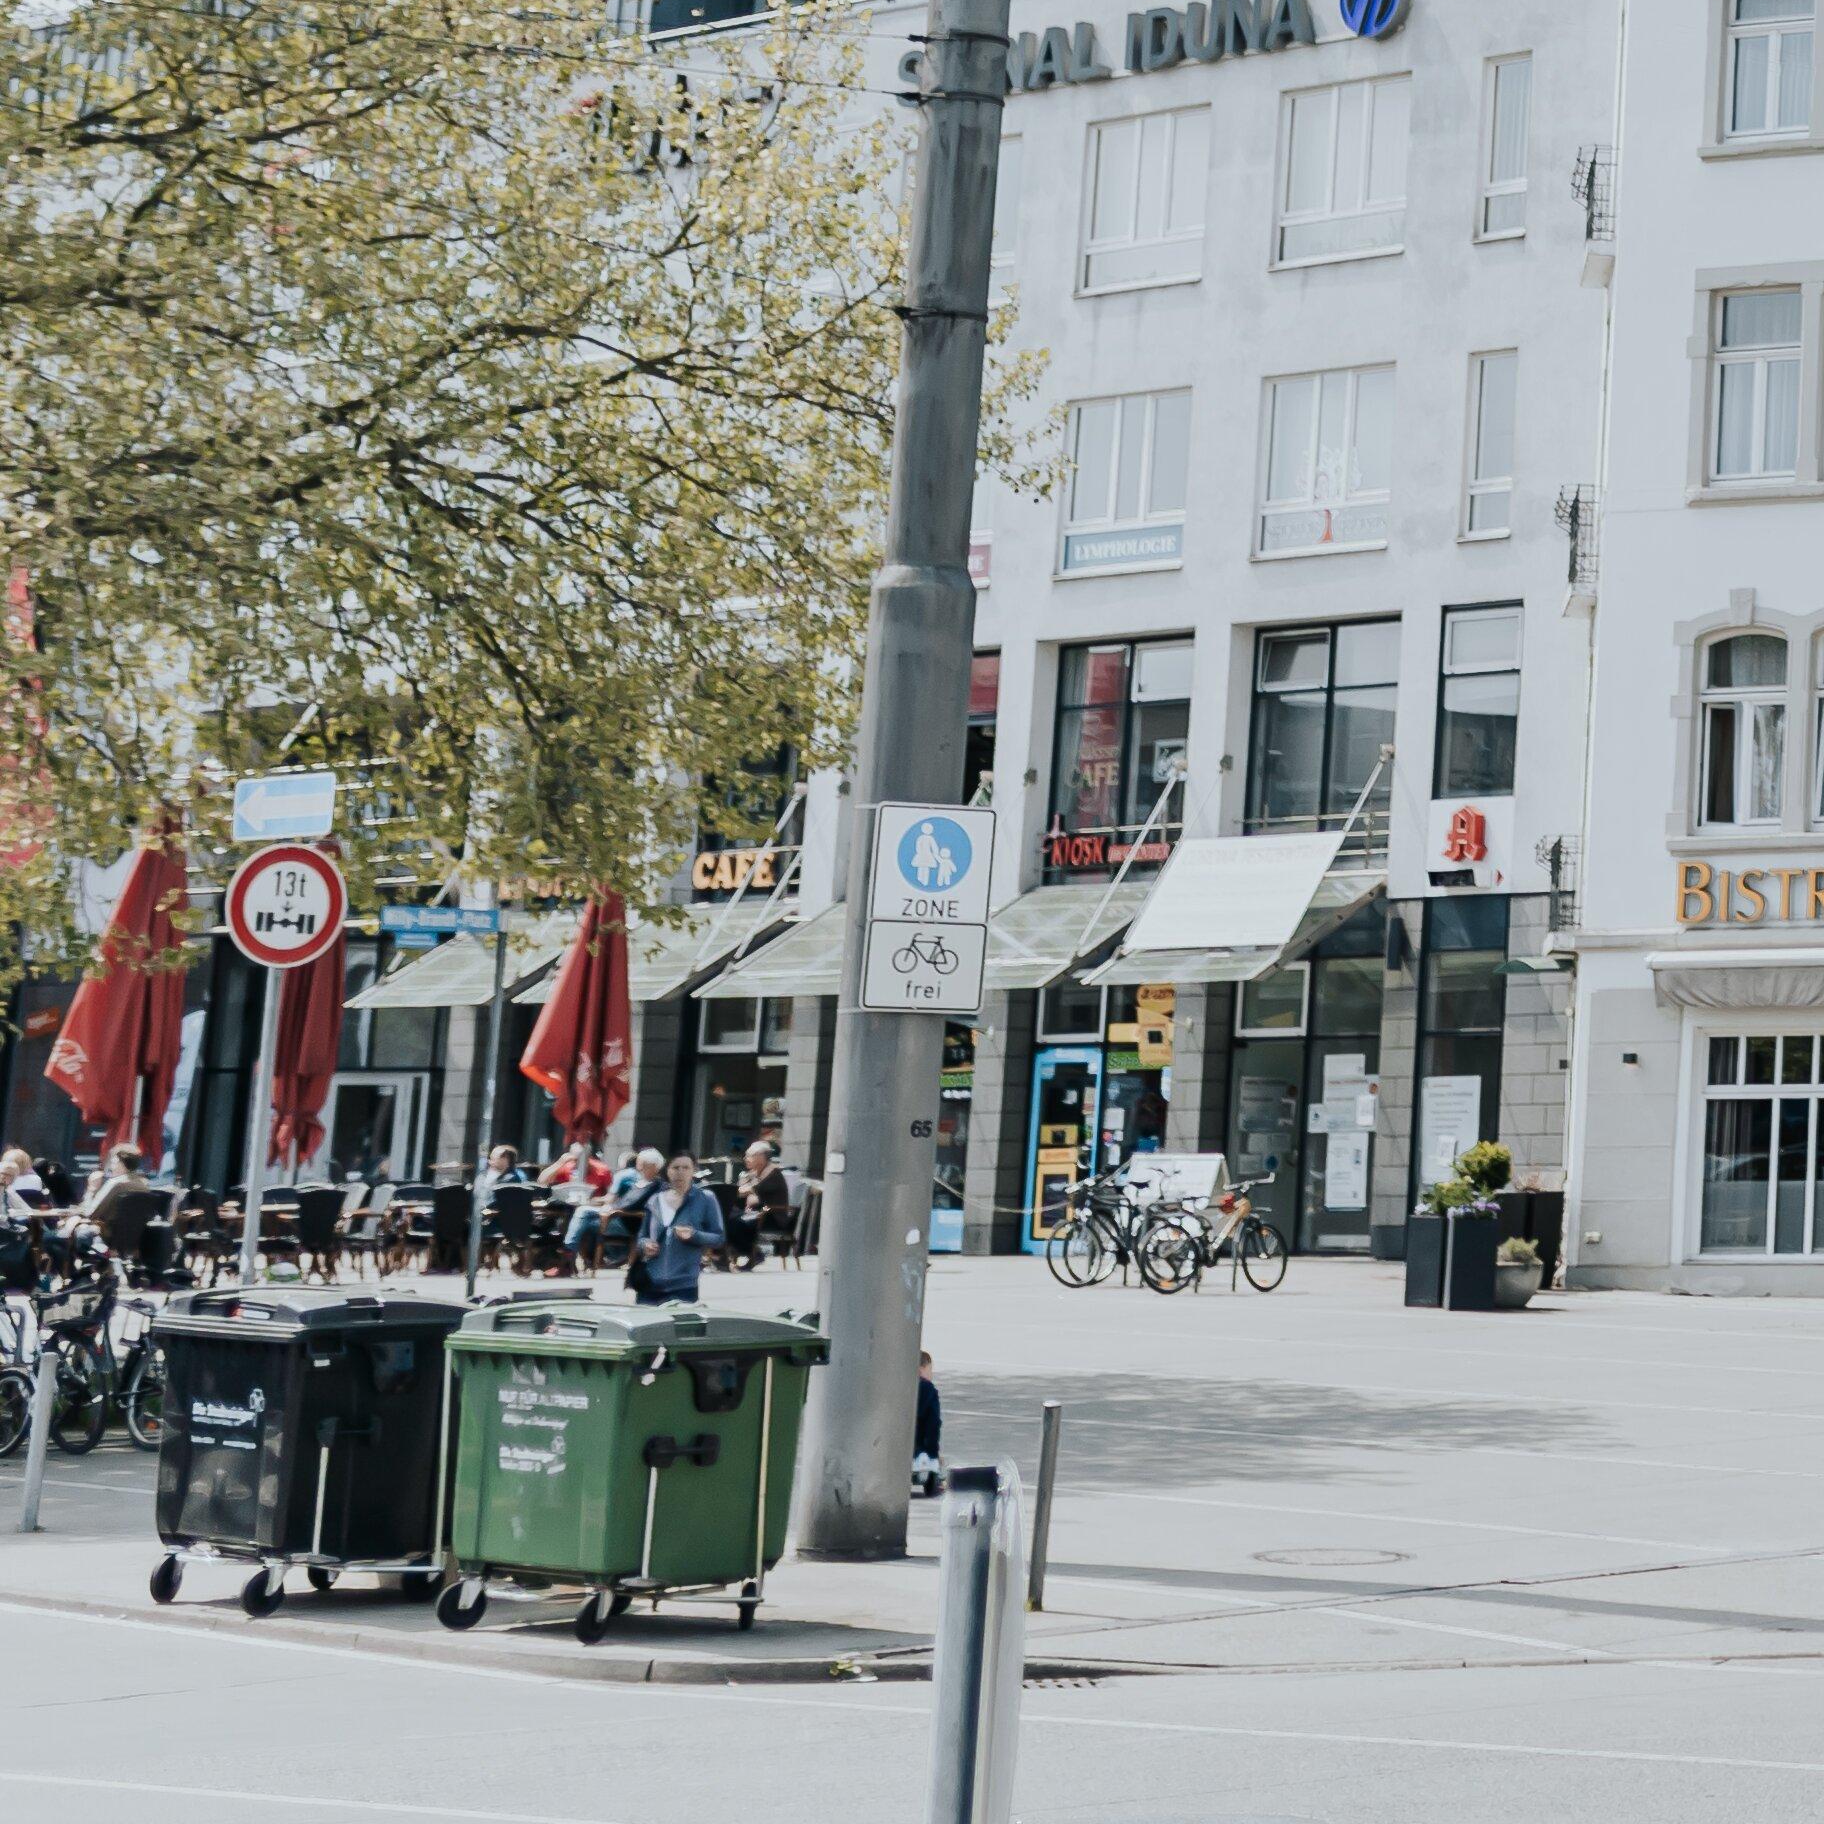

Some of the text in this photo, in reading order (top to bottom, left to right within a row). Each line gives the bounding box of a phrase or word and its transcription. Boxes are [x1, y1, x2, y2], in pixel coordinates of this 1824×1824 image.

[1074, 534, 1177, 562] LYMPHOLOGIE
[902, 898, 959, 918] ZONE
[905, 980, 941, 999] frei
